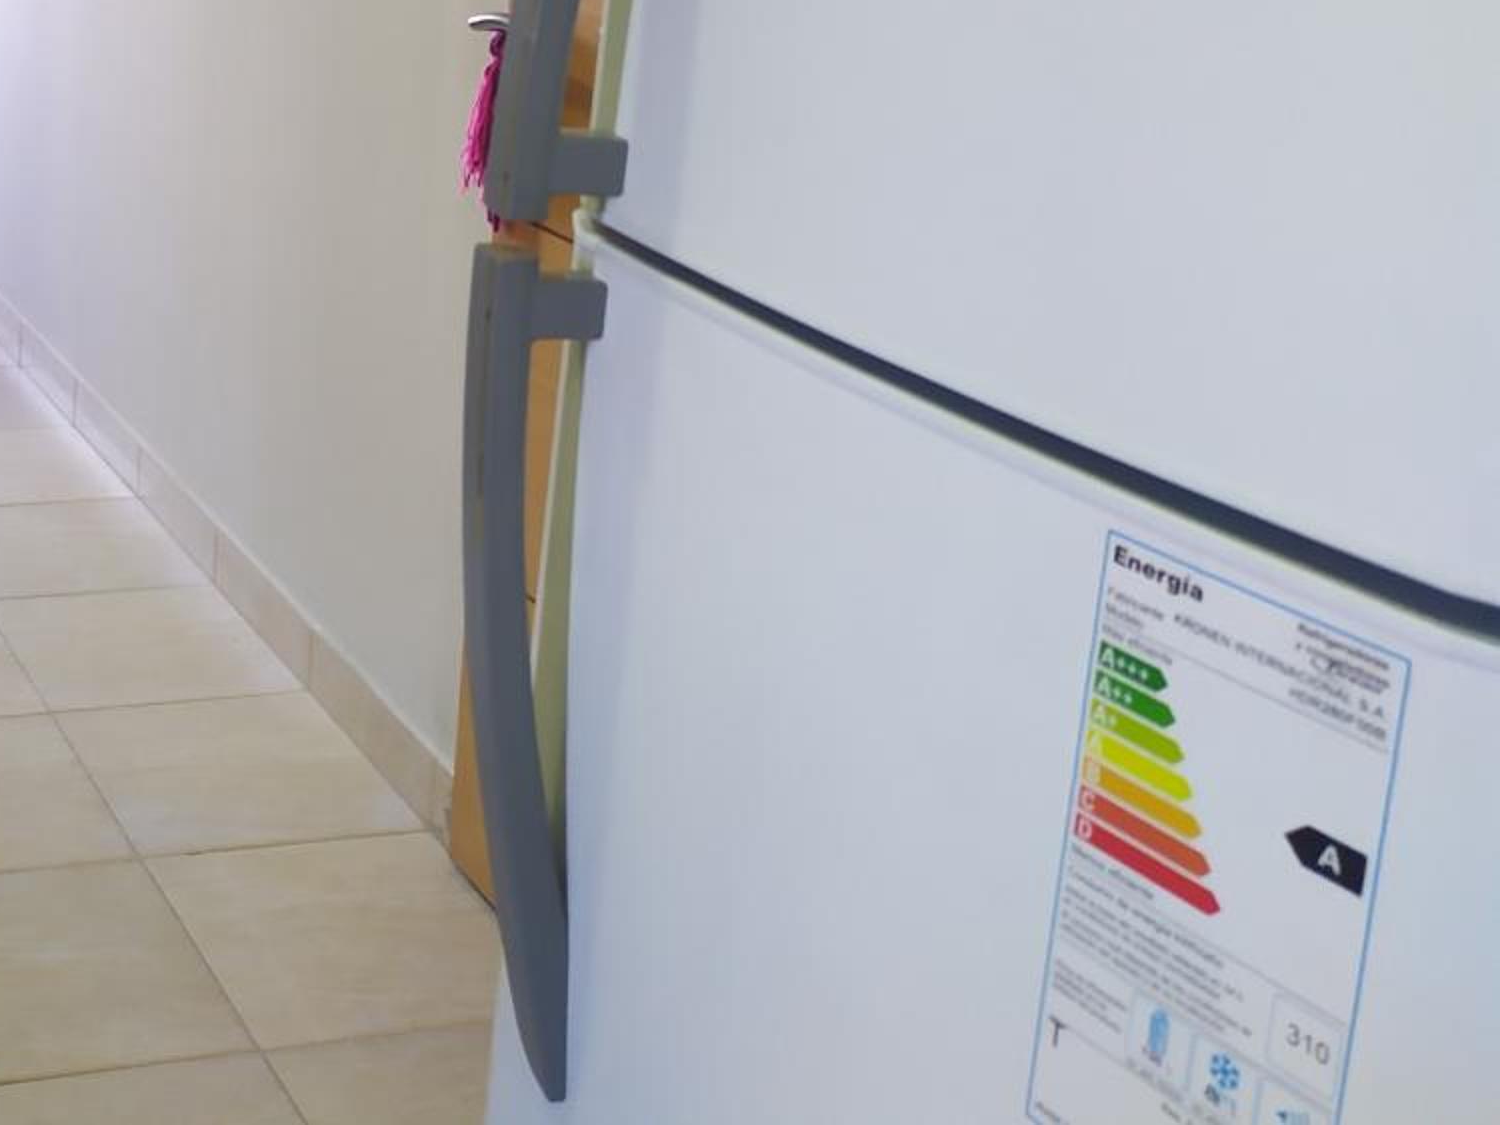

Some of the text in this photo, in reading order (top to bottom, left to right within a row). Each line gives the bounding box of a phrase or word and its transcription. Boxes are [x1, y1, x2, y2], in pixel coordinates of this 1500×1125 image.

[1077, 818, 1093, 840] D
[1317, 844, 1342, 876] A
[1286, 1022, 1331, 1066] 310
